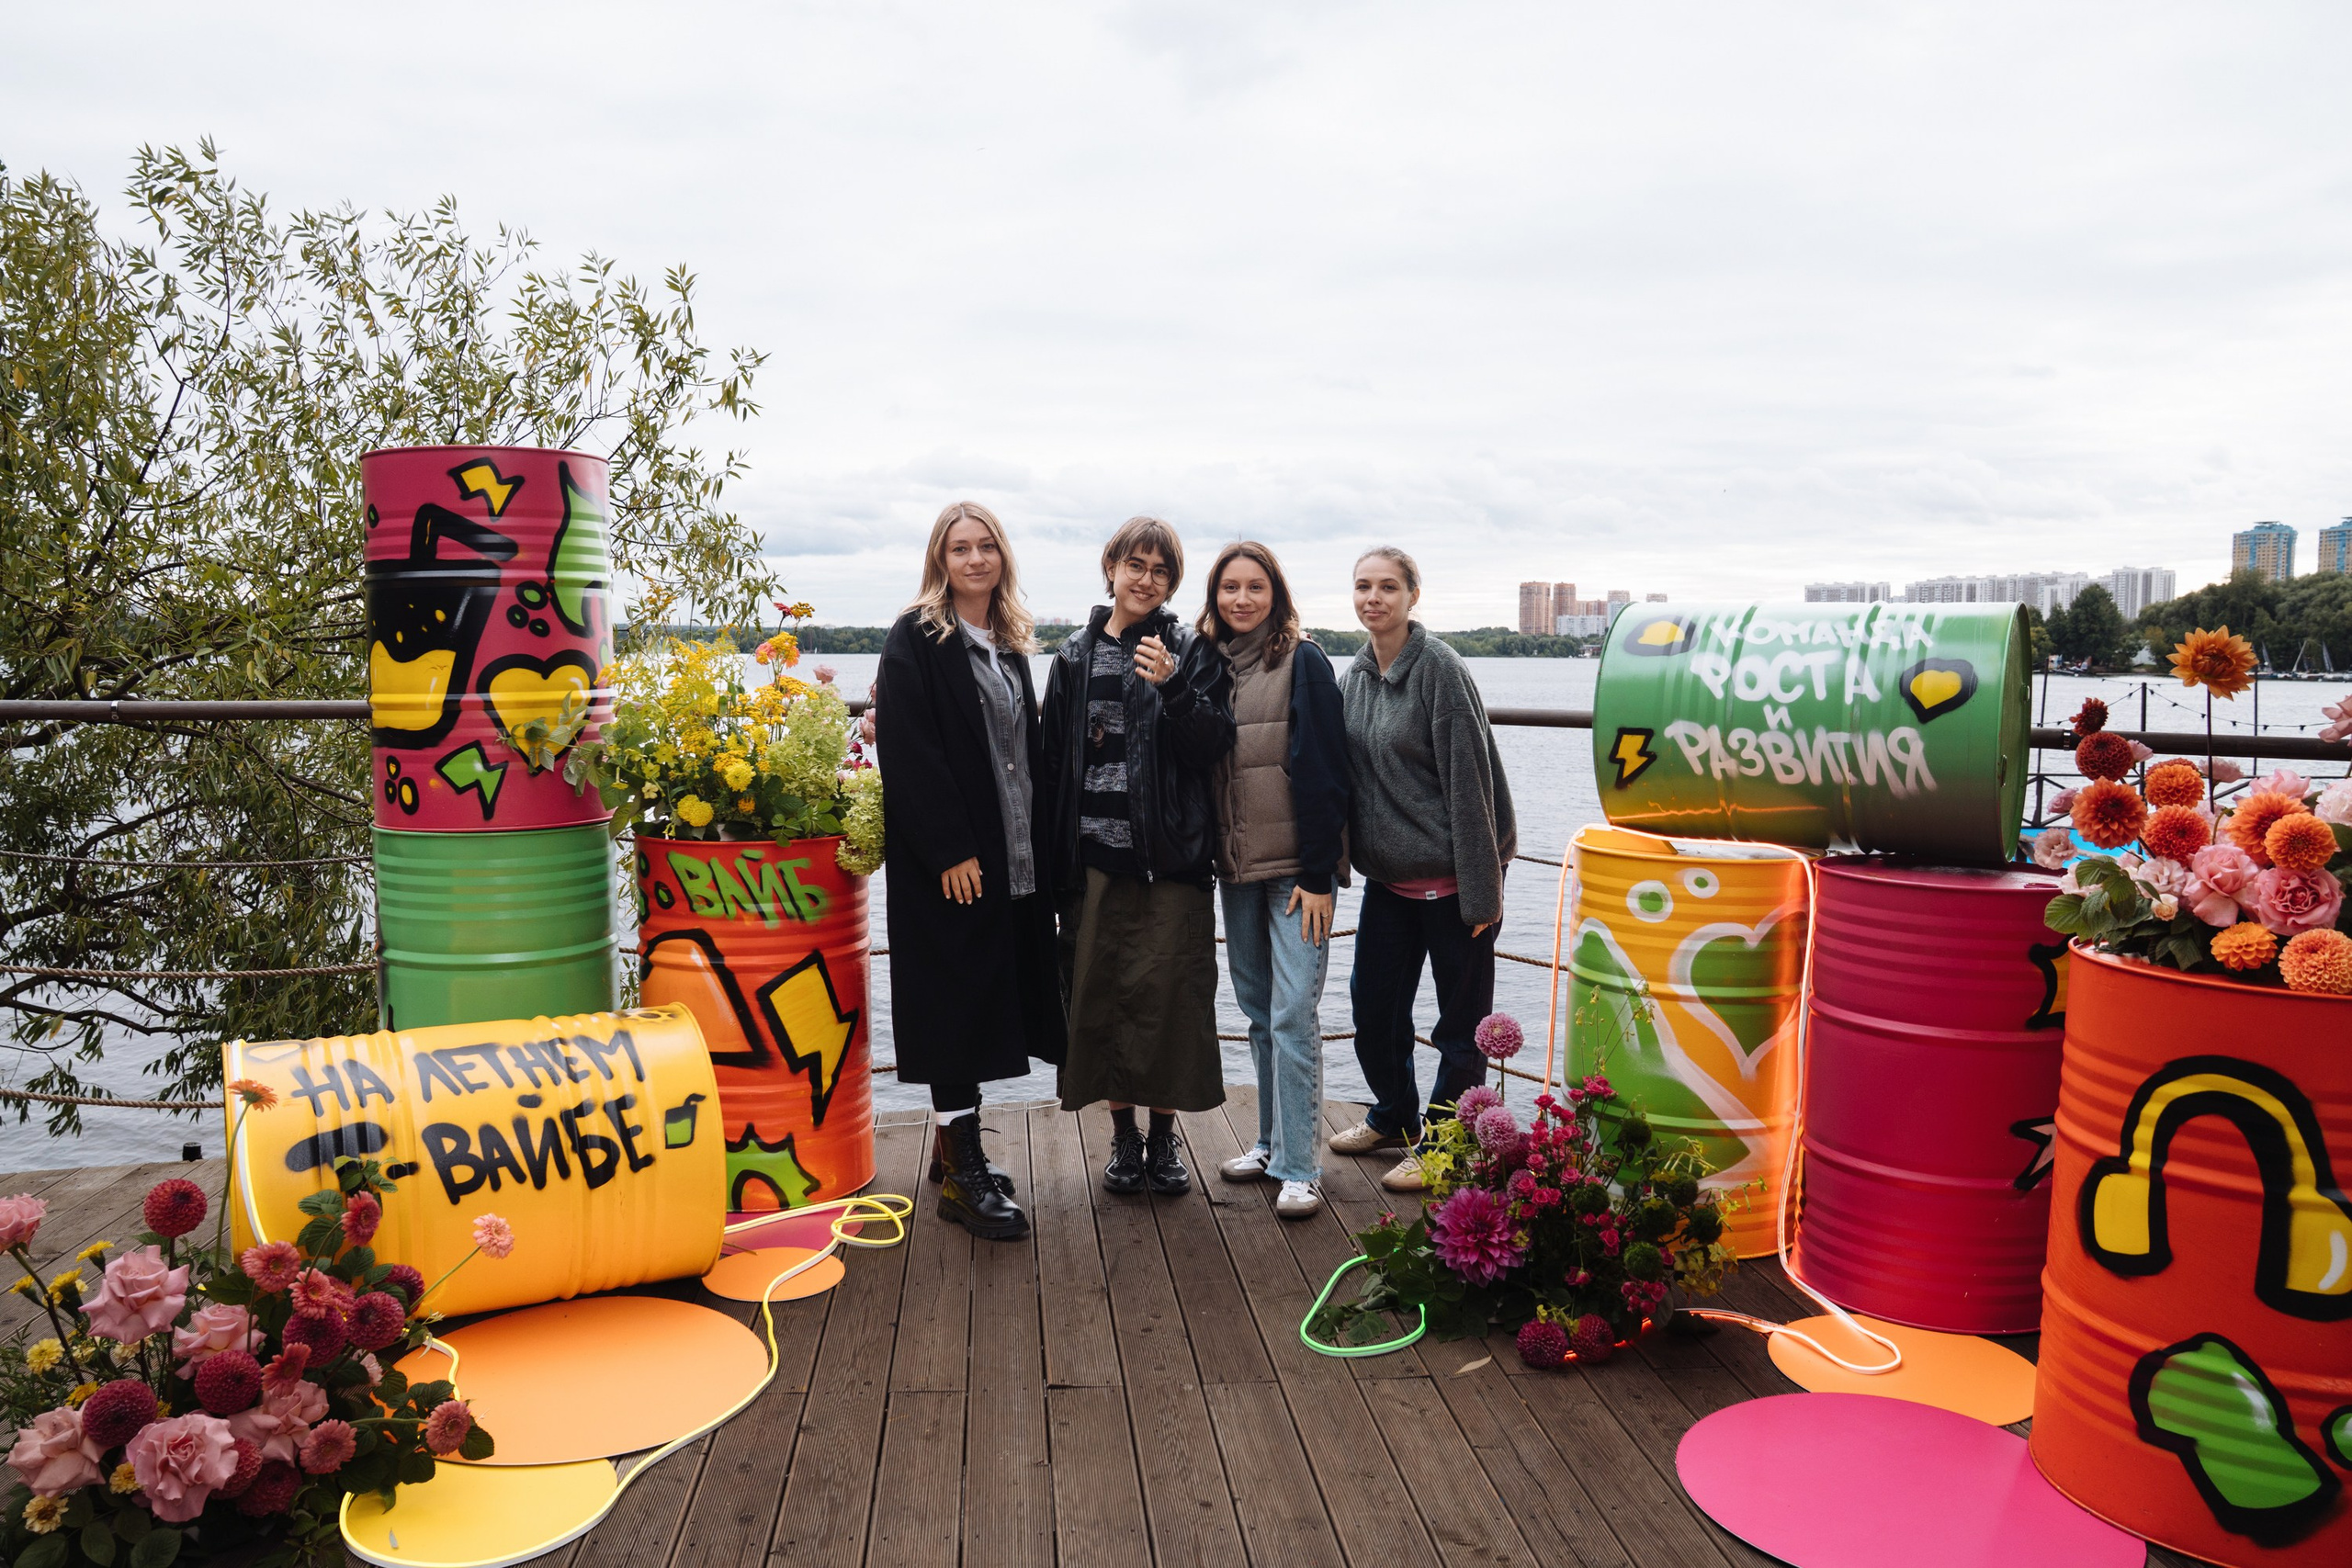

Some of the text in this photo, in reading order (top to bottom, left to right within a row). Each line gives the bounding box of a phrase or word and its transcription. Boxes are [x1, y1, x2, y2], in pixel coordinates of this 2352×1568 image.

[1690, 649, 1882, 705] РОСТА
[1664, 719, 1939, 798] РАЗВИТИЯ
[666, 848, 831, 929] ВАЙБ
[288, 1029, 646, 1118] НА ЛЕТНЕМ
